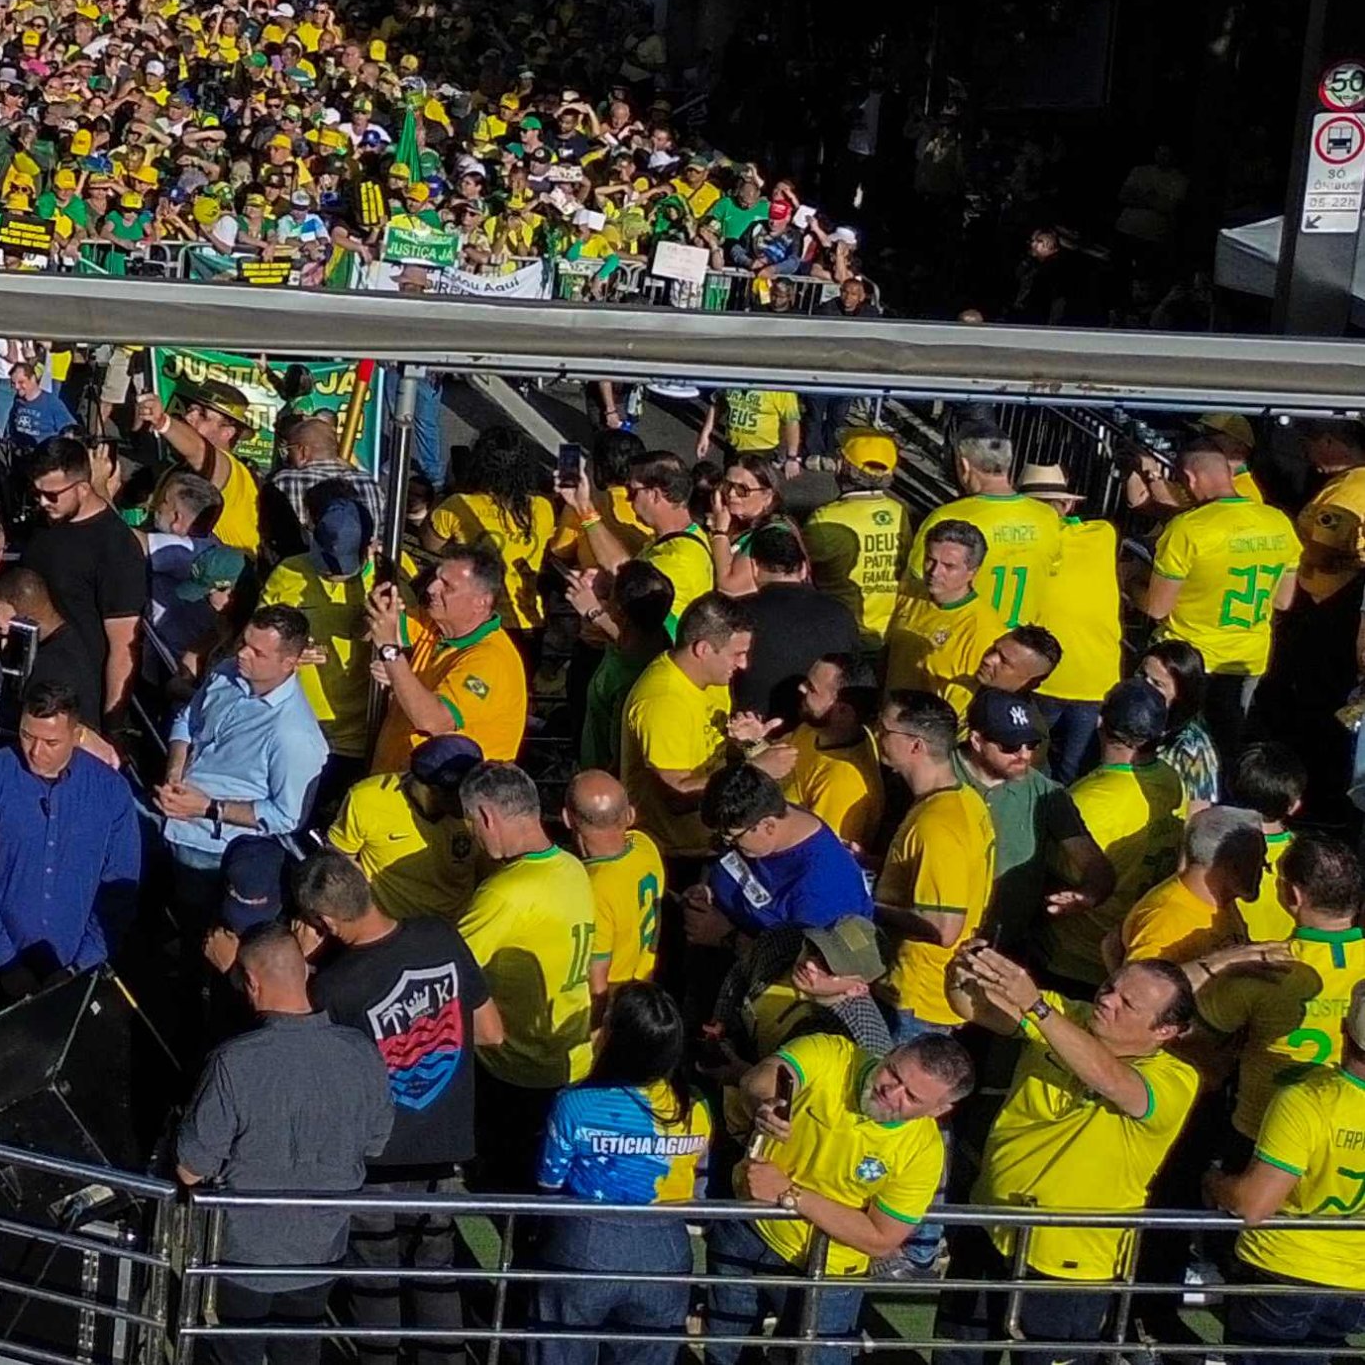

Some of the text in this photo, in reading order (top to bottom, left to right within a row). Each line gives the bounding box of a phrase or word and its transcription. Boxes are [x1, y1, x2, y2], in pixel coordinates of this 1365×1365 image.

[1331, 69, 1365, 92] 50
[387, 242, 436, 259] JUSTIÇA
[483, 277, 519, 293] Aqui
[163, 354, 282, 399] JUSTIÇ
[991, 565, 1028, 629] 11
[592, 1134, 654, 1155] LETÍCIA
[1336, 1128, 1365, 1152] CAP
